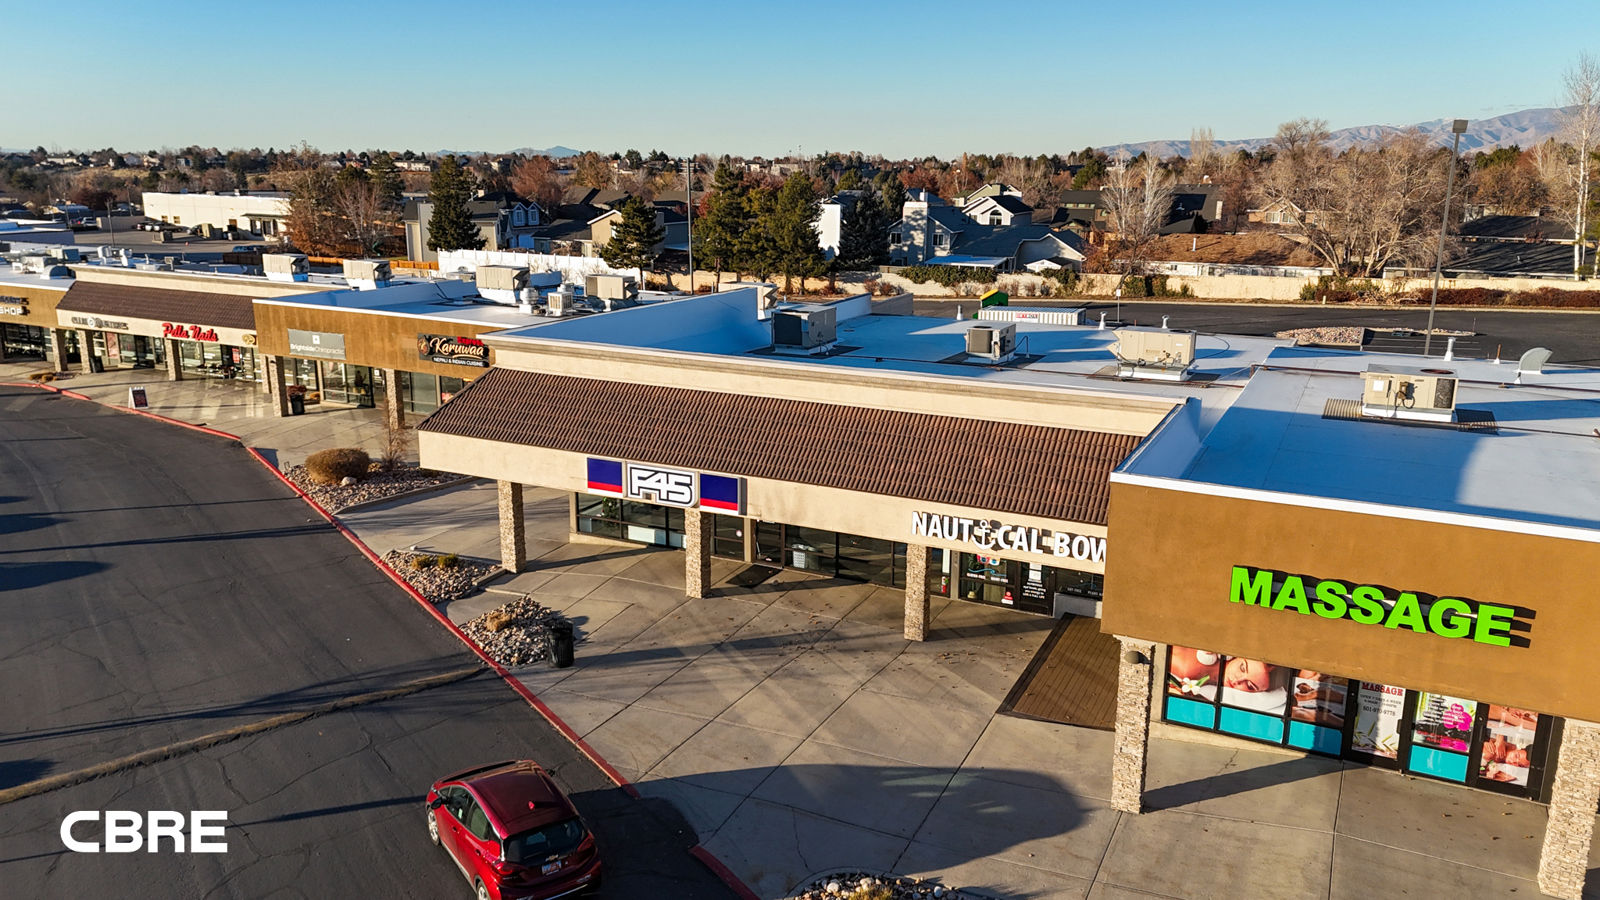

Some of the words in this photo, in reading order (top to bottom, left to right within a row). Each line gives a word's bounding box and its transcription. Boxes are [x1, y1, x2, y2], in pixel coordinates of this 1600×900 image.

[189, 325, 218, 341] Nails
[430, 337, 484, 355] Karuwaa
[630, 466, 693, 504] F45
[1229, 566, 1515, 647] MASSAGE
[1361, 682, 1404, 696] MASSAGE
